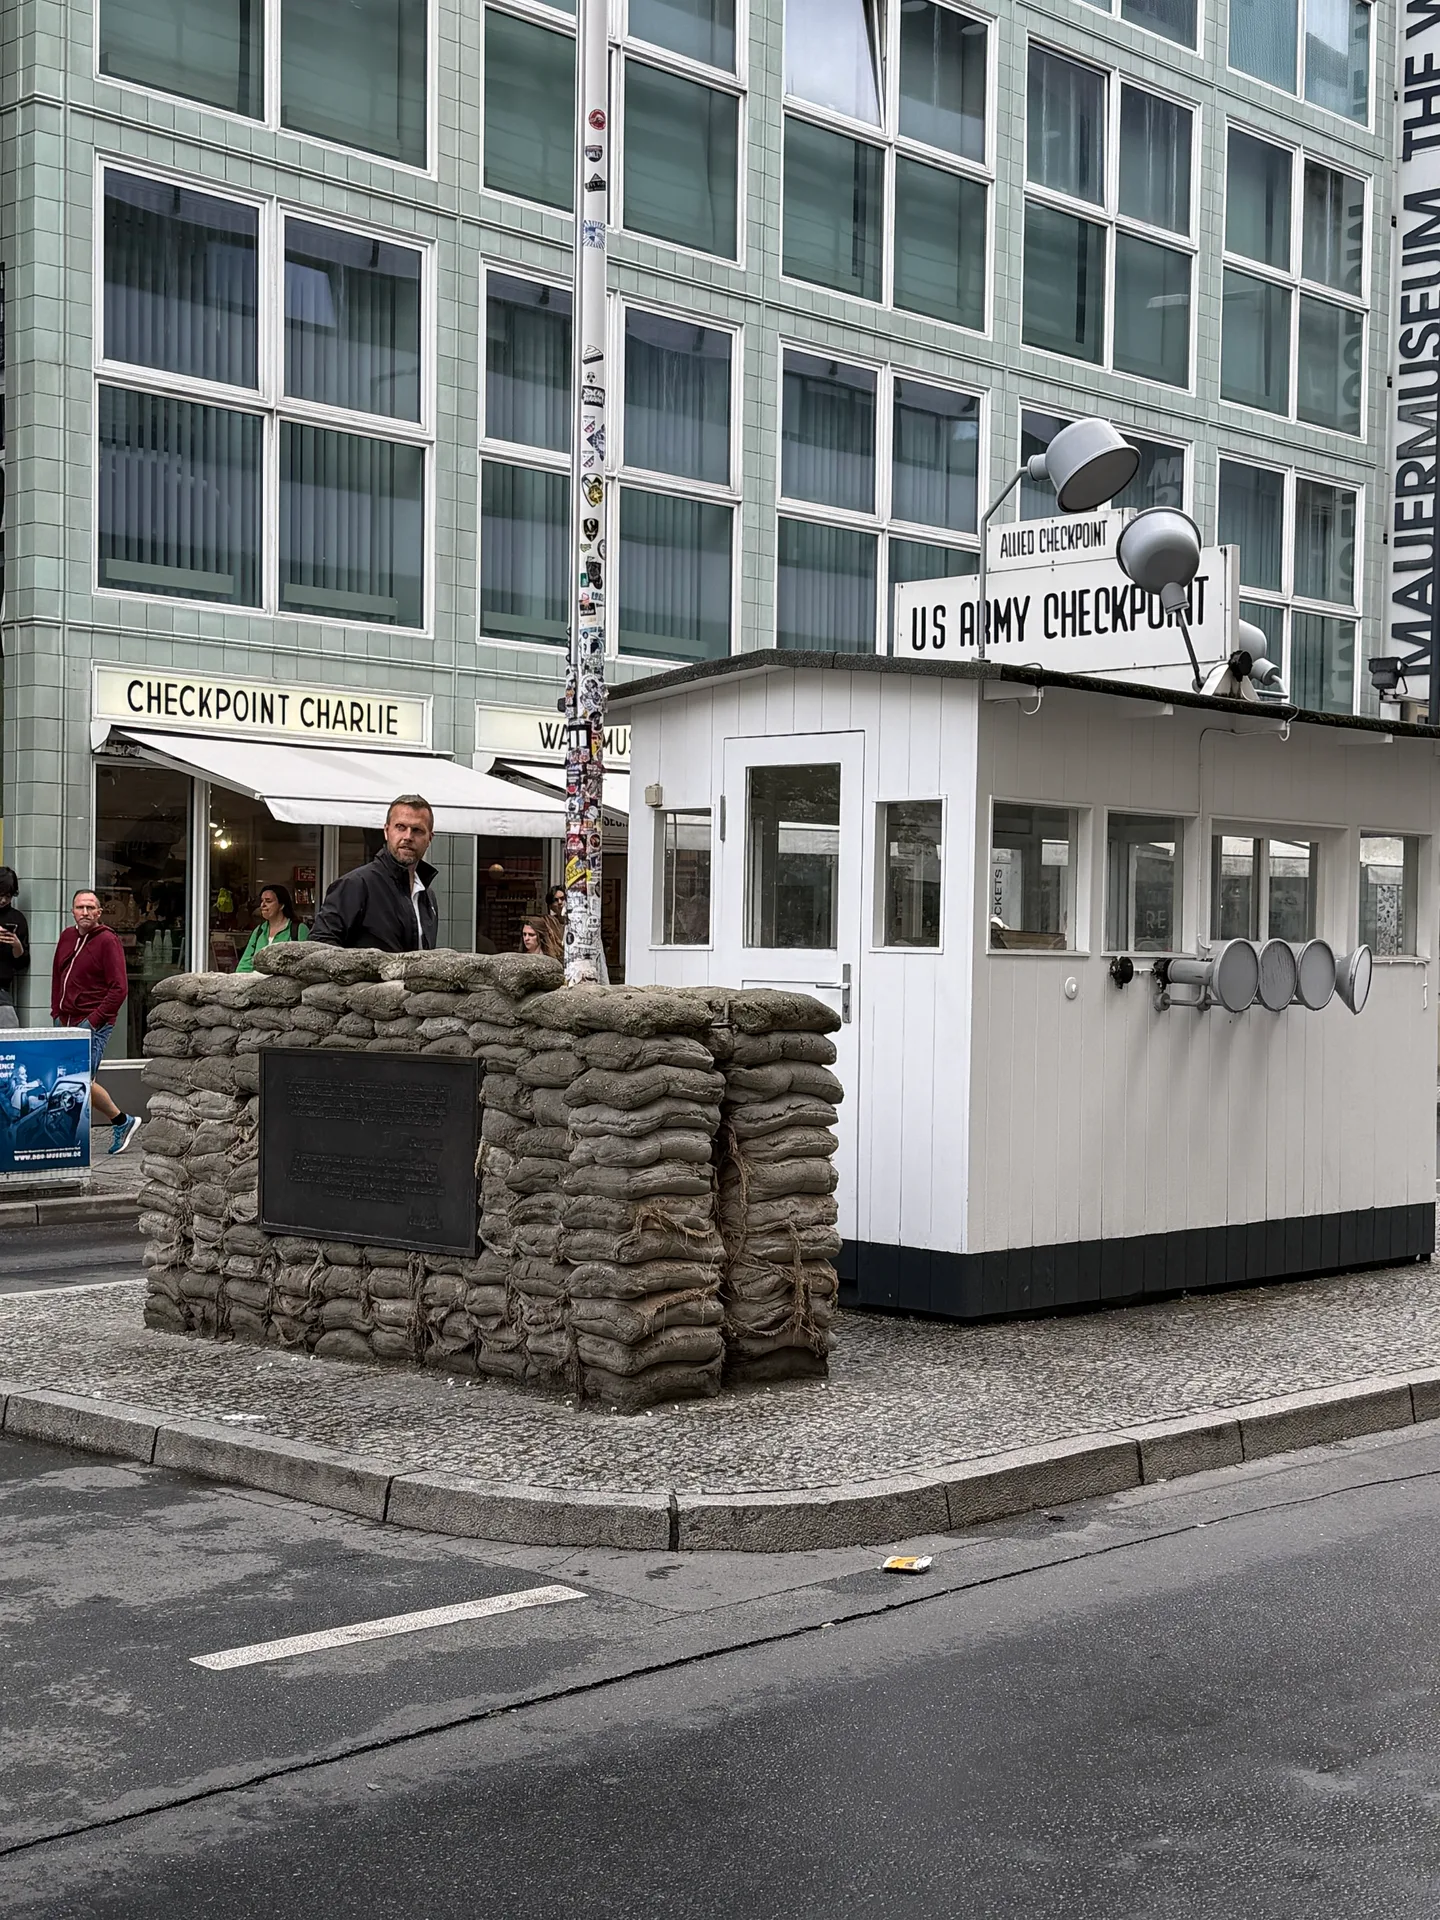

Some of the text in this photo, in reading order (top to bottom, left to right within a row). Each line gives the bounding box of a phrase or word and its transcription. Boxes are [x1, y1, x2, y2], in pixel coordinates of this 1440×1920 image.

[1403, 53, 1440, 162] THE
[1392, 187, 1440, 677] MAUERMUSEUM
[1000, 520, 1108, 559] ALLIED CHECKPOINT
[911, 576, 1209, 651] US ARMY CHECKPONT
[127, 680, 399, 735] CHECKPOINT CHARLIE
